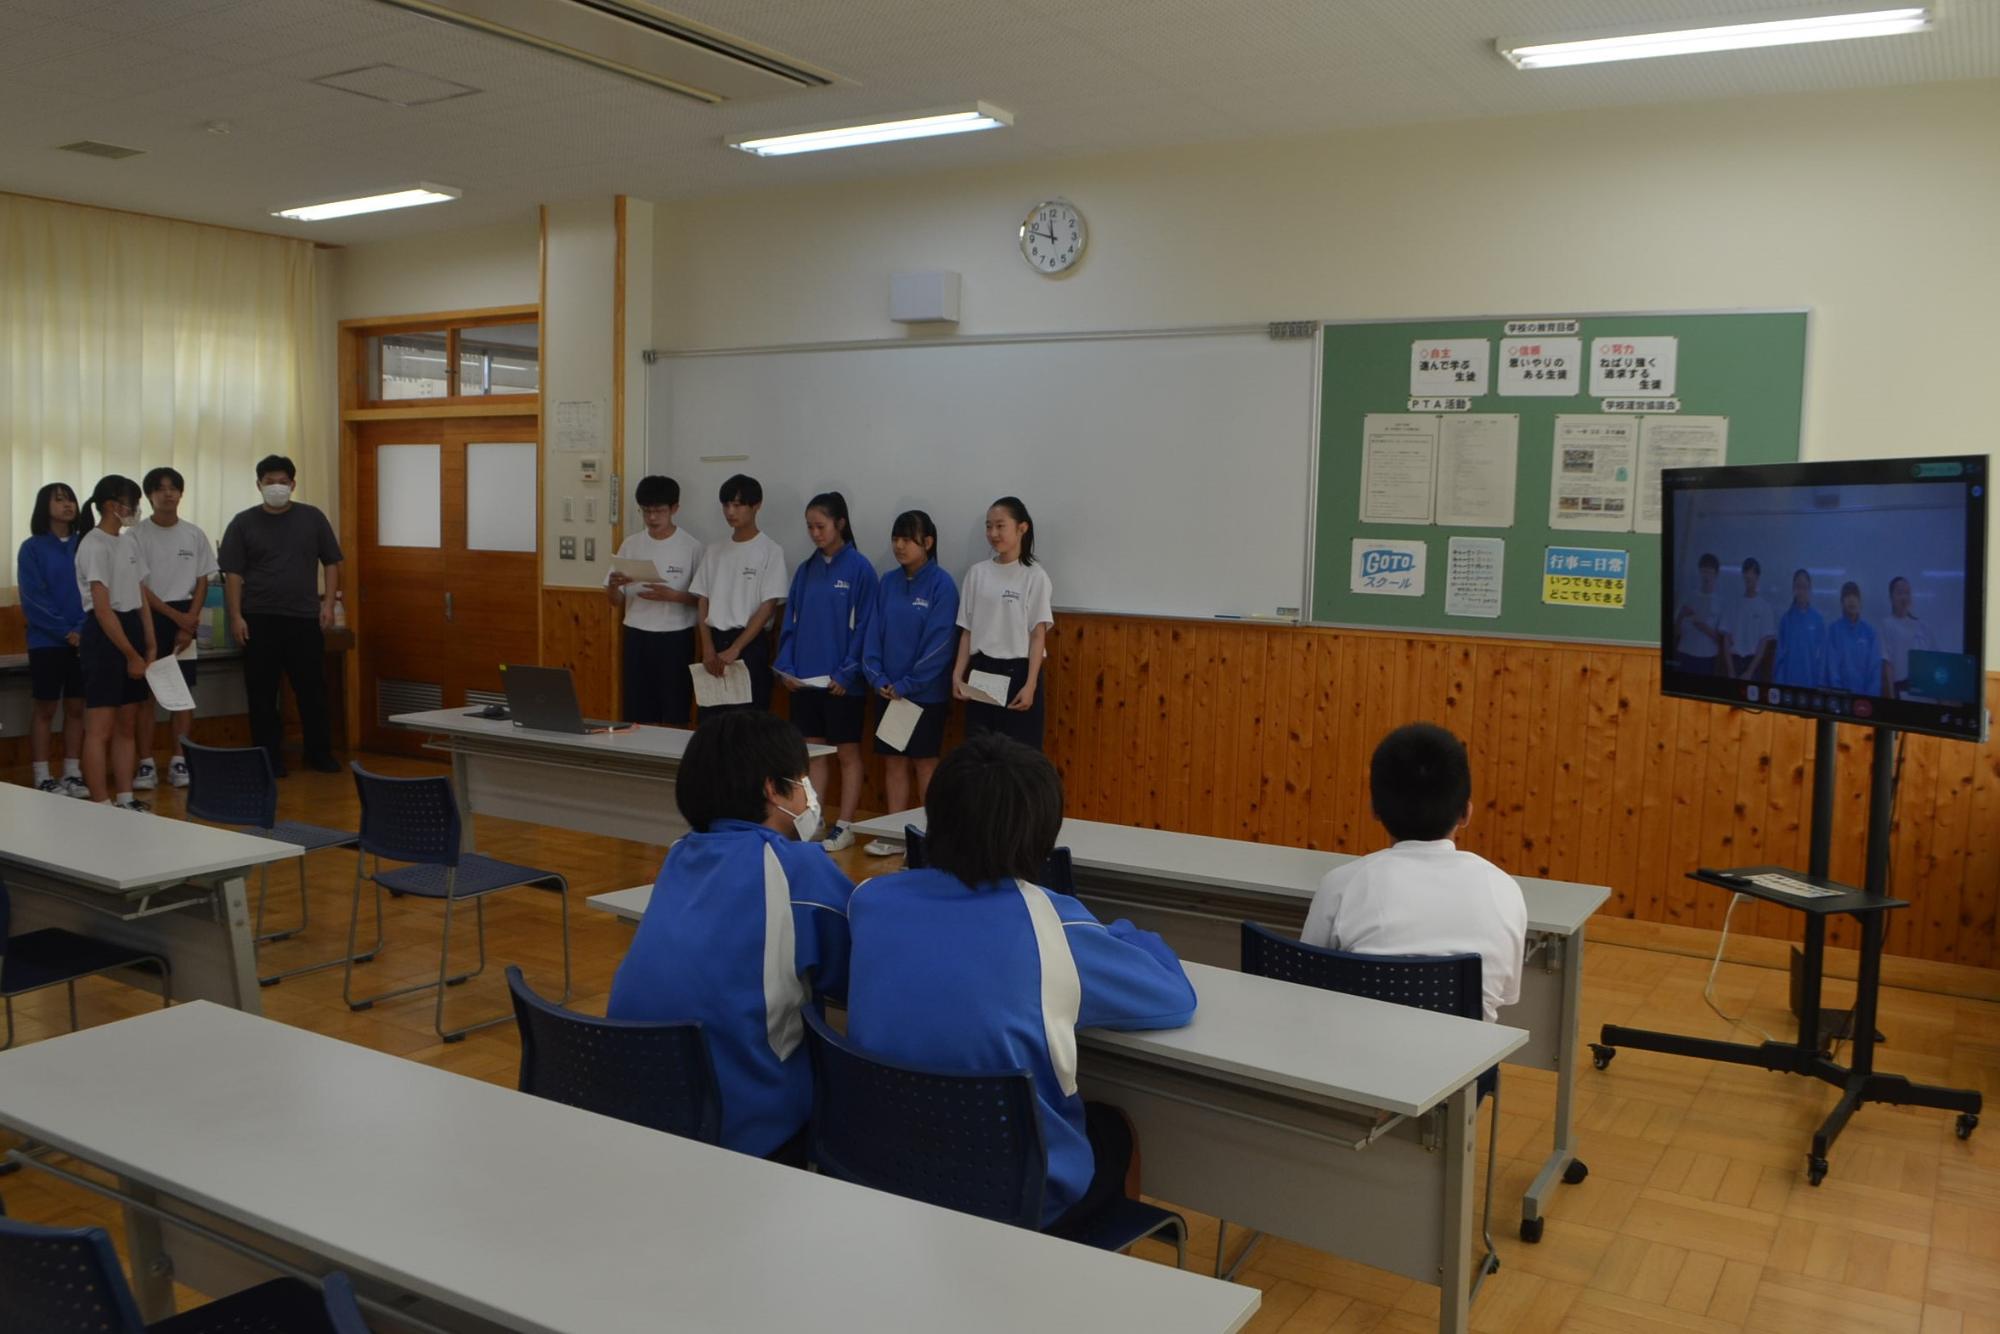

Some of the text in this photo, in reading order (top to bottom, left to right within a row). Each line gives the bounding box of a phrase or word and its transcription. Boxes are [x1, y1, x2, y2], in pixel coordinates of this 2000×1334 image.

[1430, 348, 1452, 359] 自主
[1612, 344, 1634, 354] 努力
[1420, 360, 1470, 371] 進んで学ぶ
[1509, 358, 1564, 368] 思いやりの
[1600, 358, 1656, 368] ねばり強く
[1455, 372, 1477, 382] 生徒
[1523, 369, 1568, 380] ある生徒
[1639, 380, 1662, 390] 生徒
[1363, 576, 1413, 589] スクール
[1550, 576, 1624, 589] いつでもできる
[1550, 589, 1623, 603] どこでもできる
